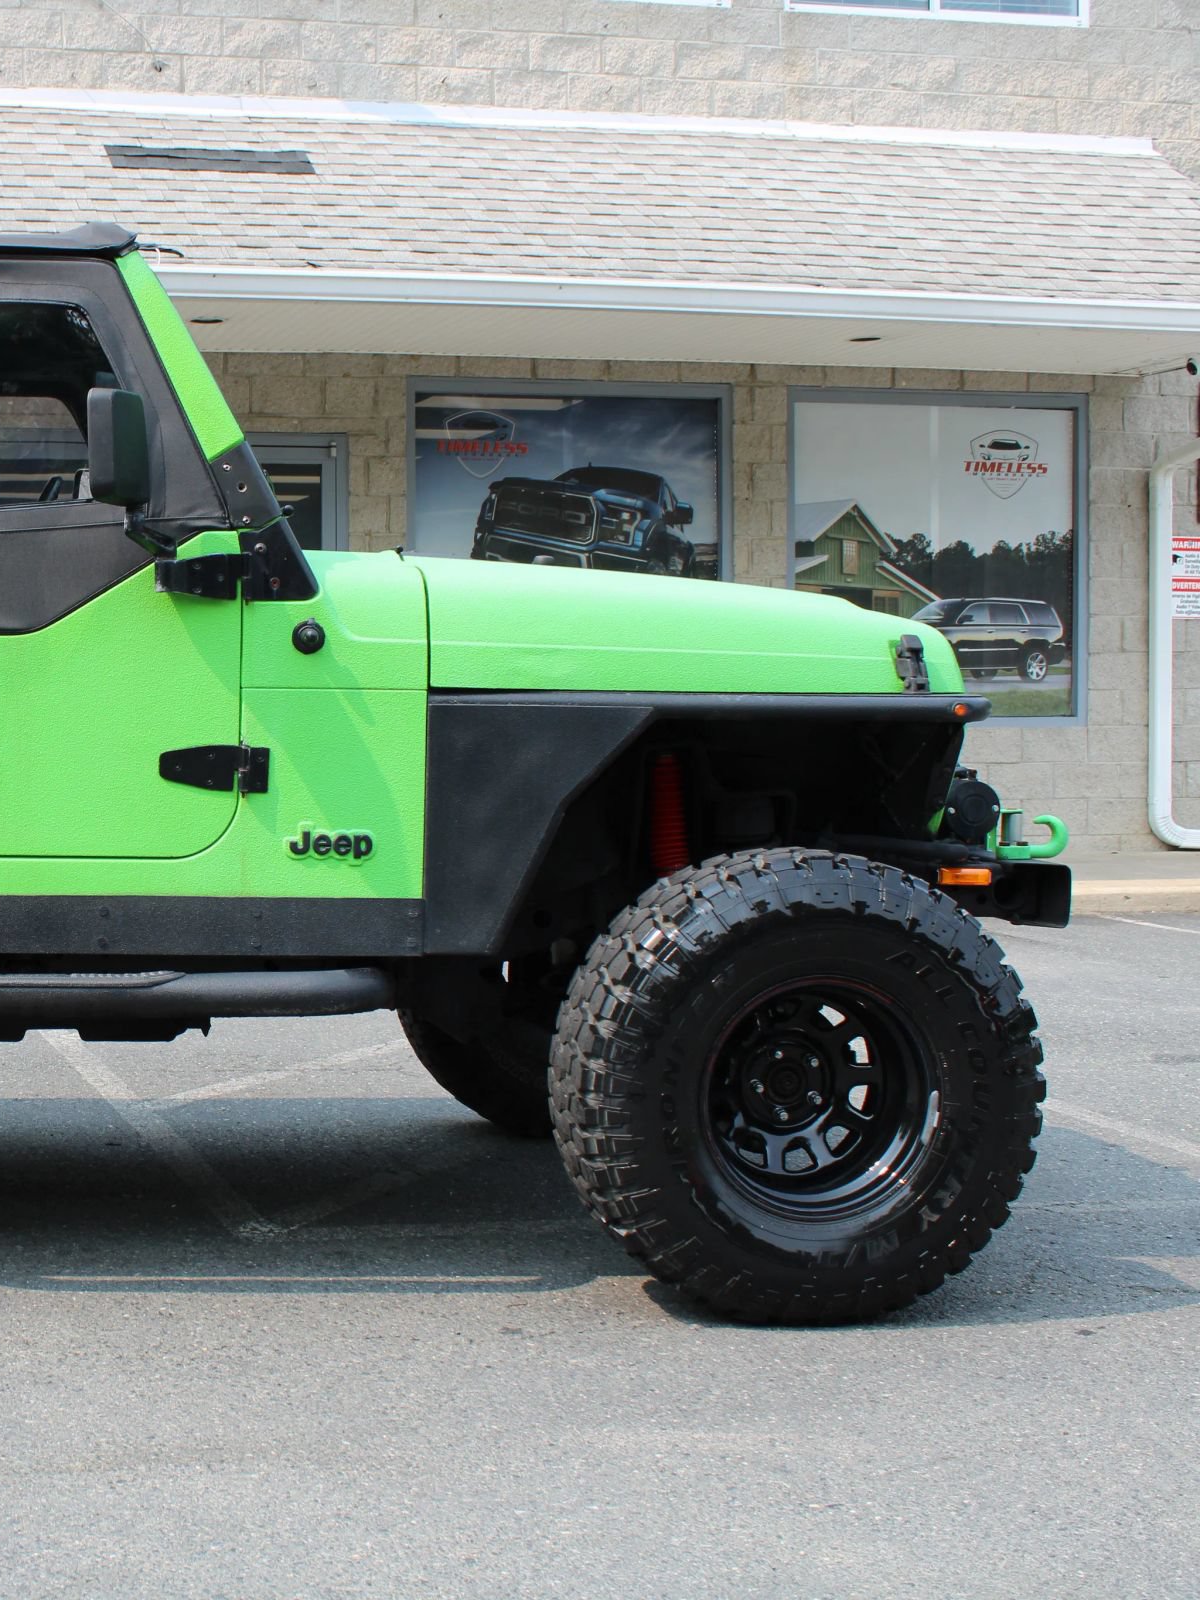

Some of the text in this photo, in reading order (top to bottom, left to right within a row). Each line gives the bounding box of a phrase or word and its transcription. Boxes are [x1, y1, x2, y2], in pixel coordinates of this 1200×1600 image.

[437, 439, 529, 454] TIMELESS
[964, 461, 1048, 474] TIMELESS
[289, 831, 373, 859] Jeep
